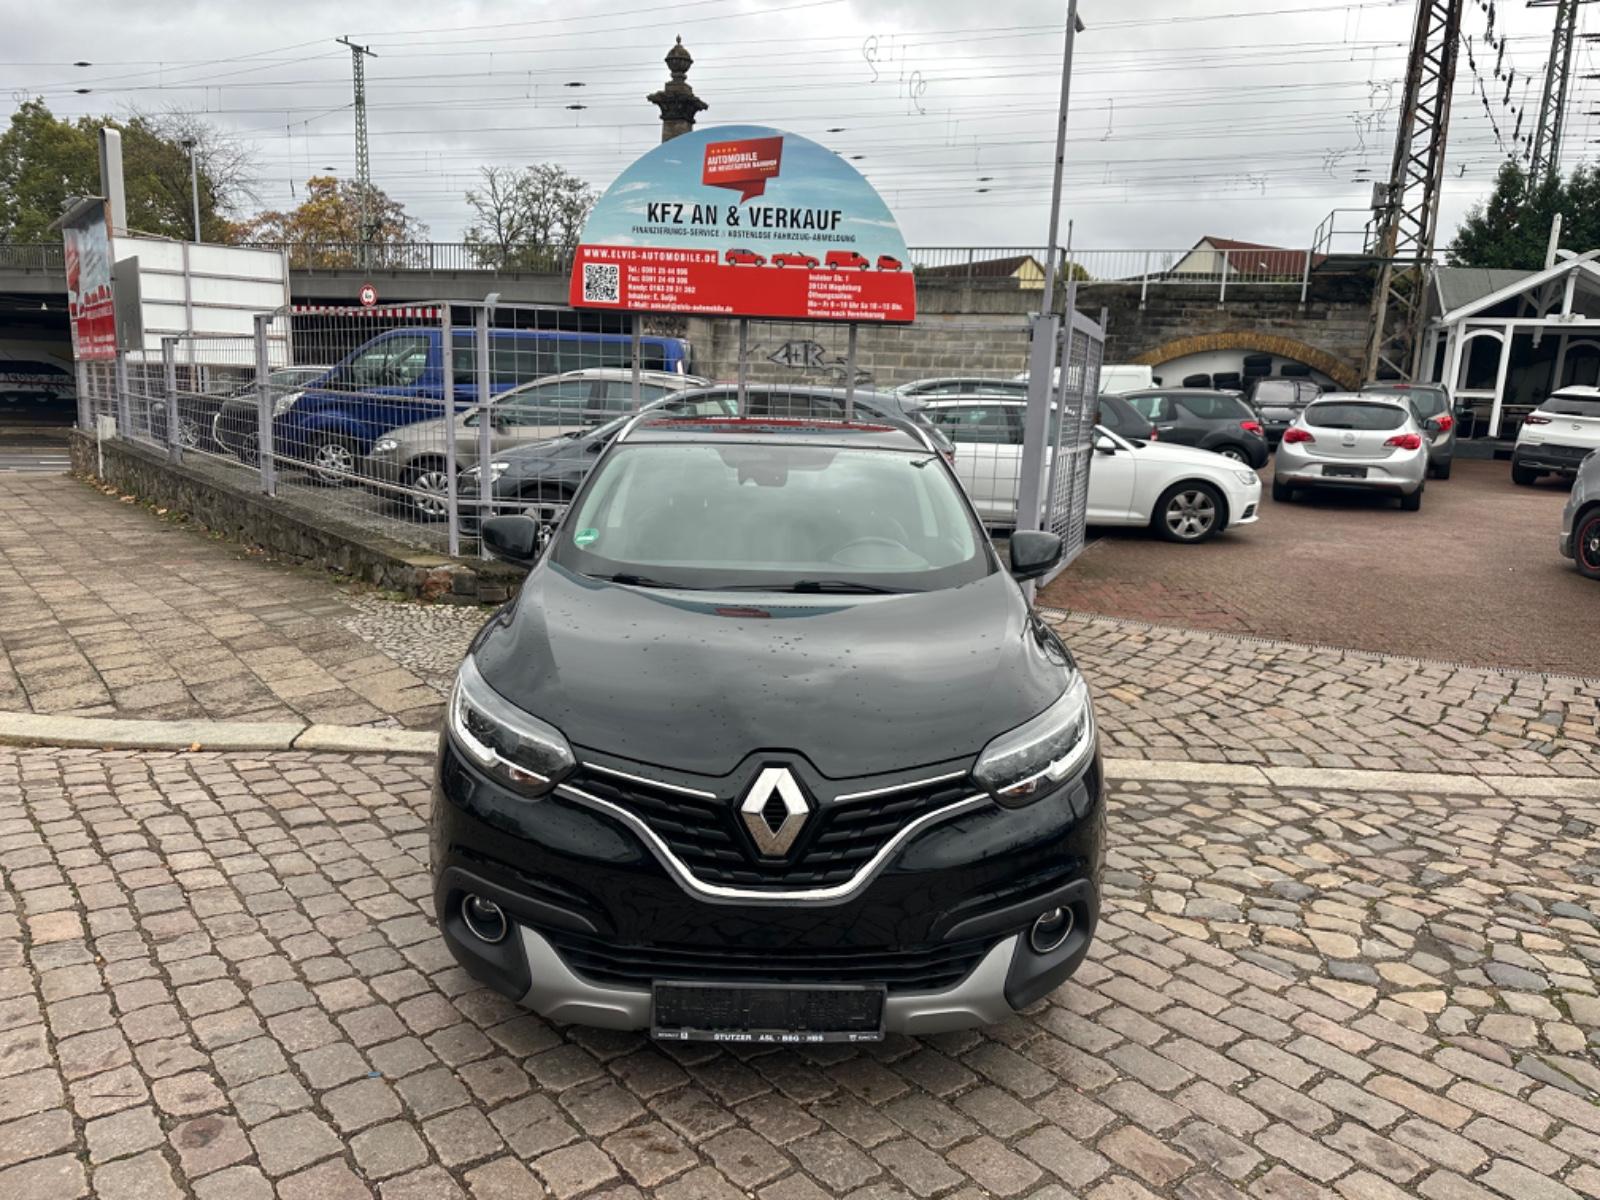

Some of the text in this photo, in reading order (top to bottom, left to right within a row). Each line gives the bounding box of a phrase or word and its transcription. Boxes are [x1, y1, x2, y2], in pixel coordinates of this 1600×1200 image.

[707, 152, 758, 165] AUTOMOBILE
[647, 202, 842, 230] KFZ AN & VERKAUF
[632, 226, 719, 237] FINANZIERUNGS-SERVICE
[728, 230, 771, 240] KOSTENLOSE
[583, 249, 717, 263] WWW.ELVIS-AUTOMOBILE.DE
[713, 1033, 752, 1041] STUTZER
